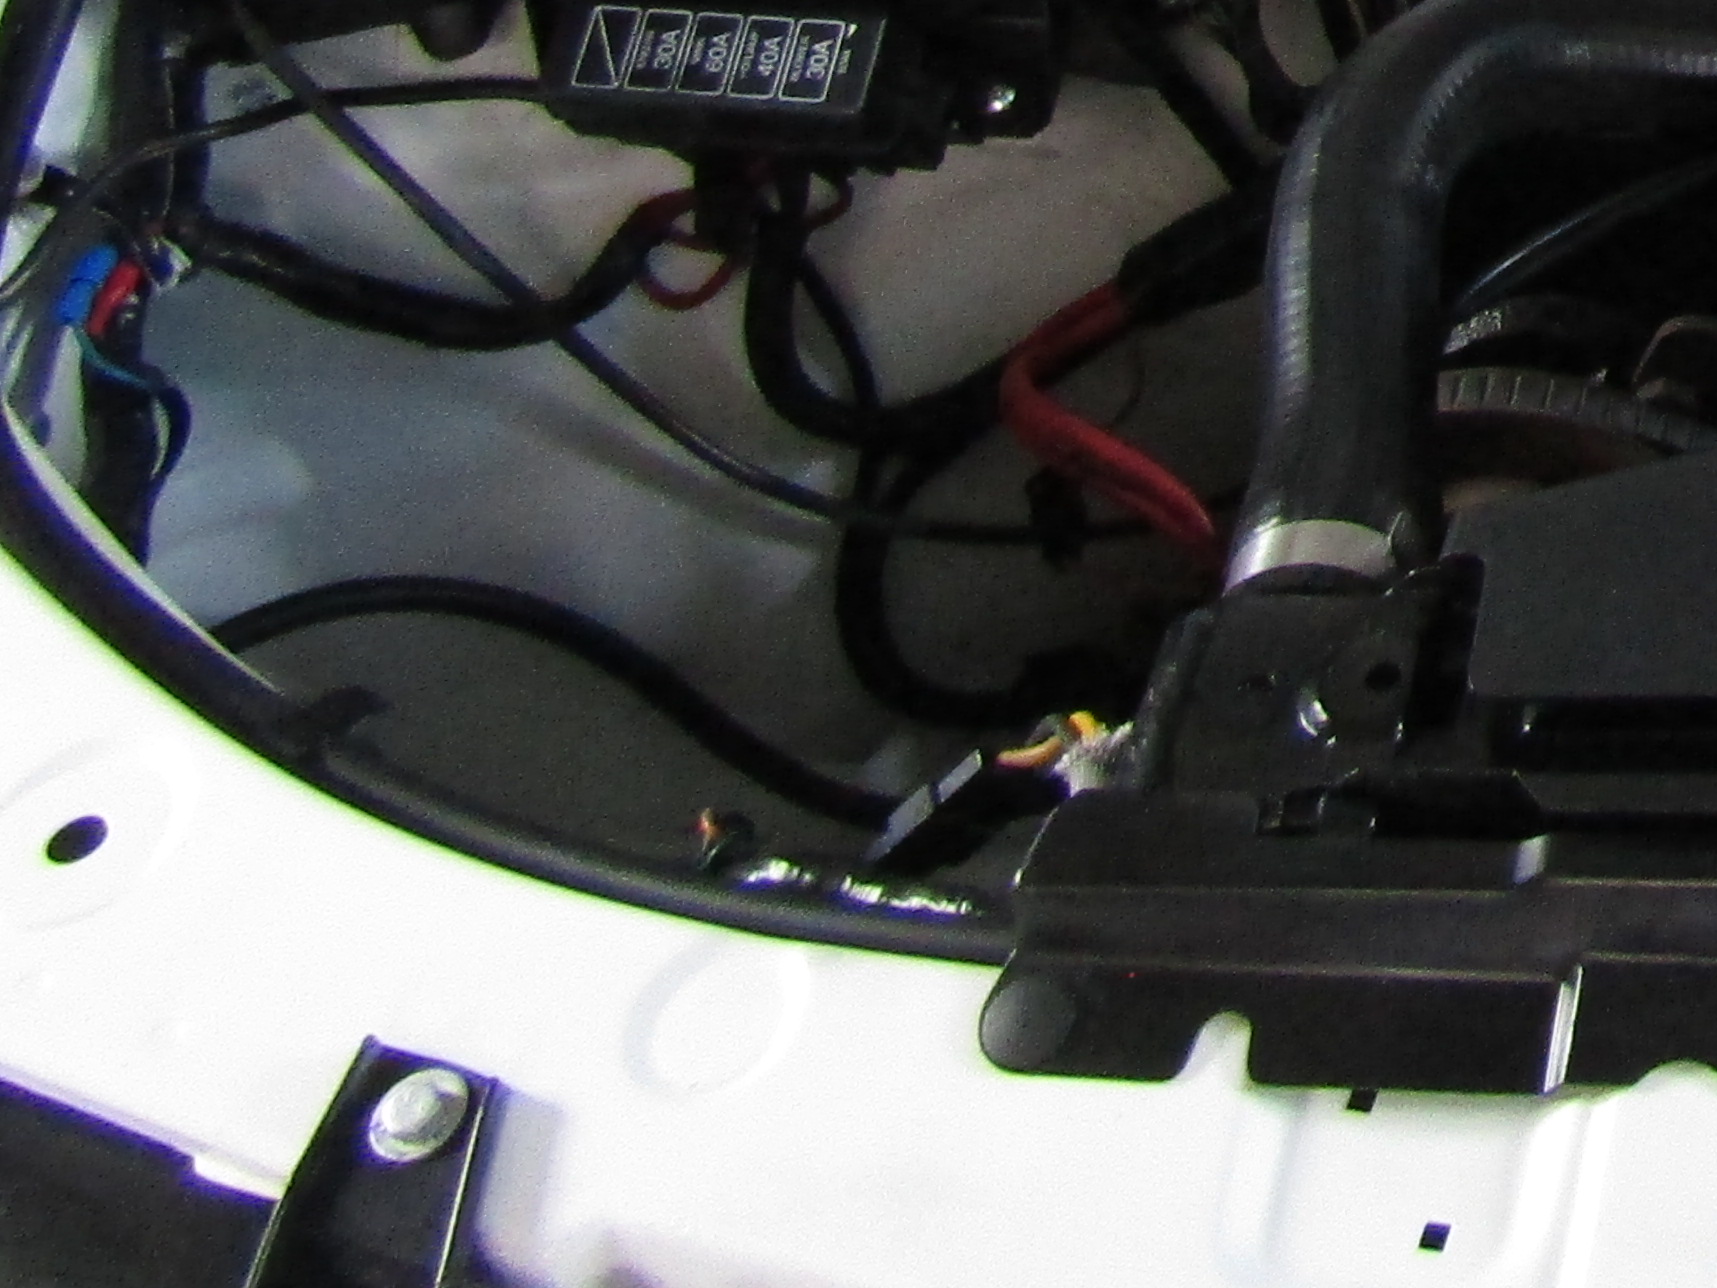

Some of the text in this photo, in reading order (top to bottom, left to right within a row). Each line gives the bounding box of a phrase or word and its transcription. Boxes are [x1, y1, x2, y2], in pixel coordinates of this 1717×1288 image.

[653, 29, 682, 71] 30A
[705, 31, 732, 73] 60A
[757, 34, 784, 77] 40A
[805, 38, 835, 81] 30A
